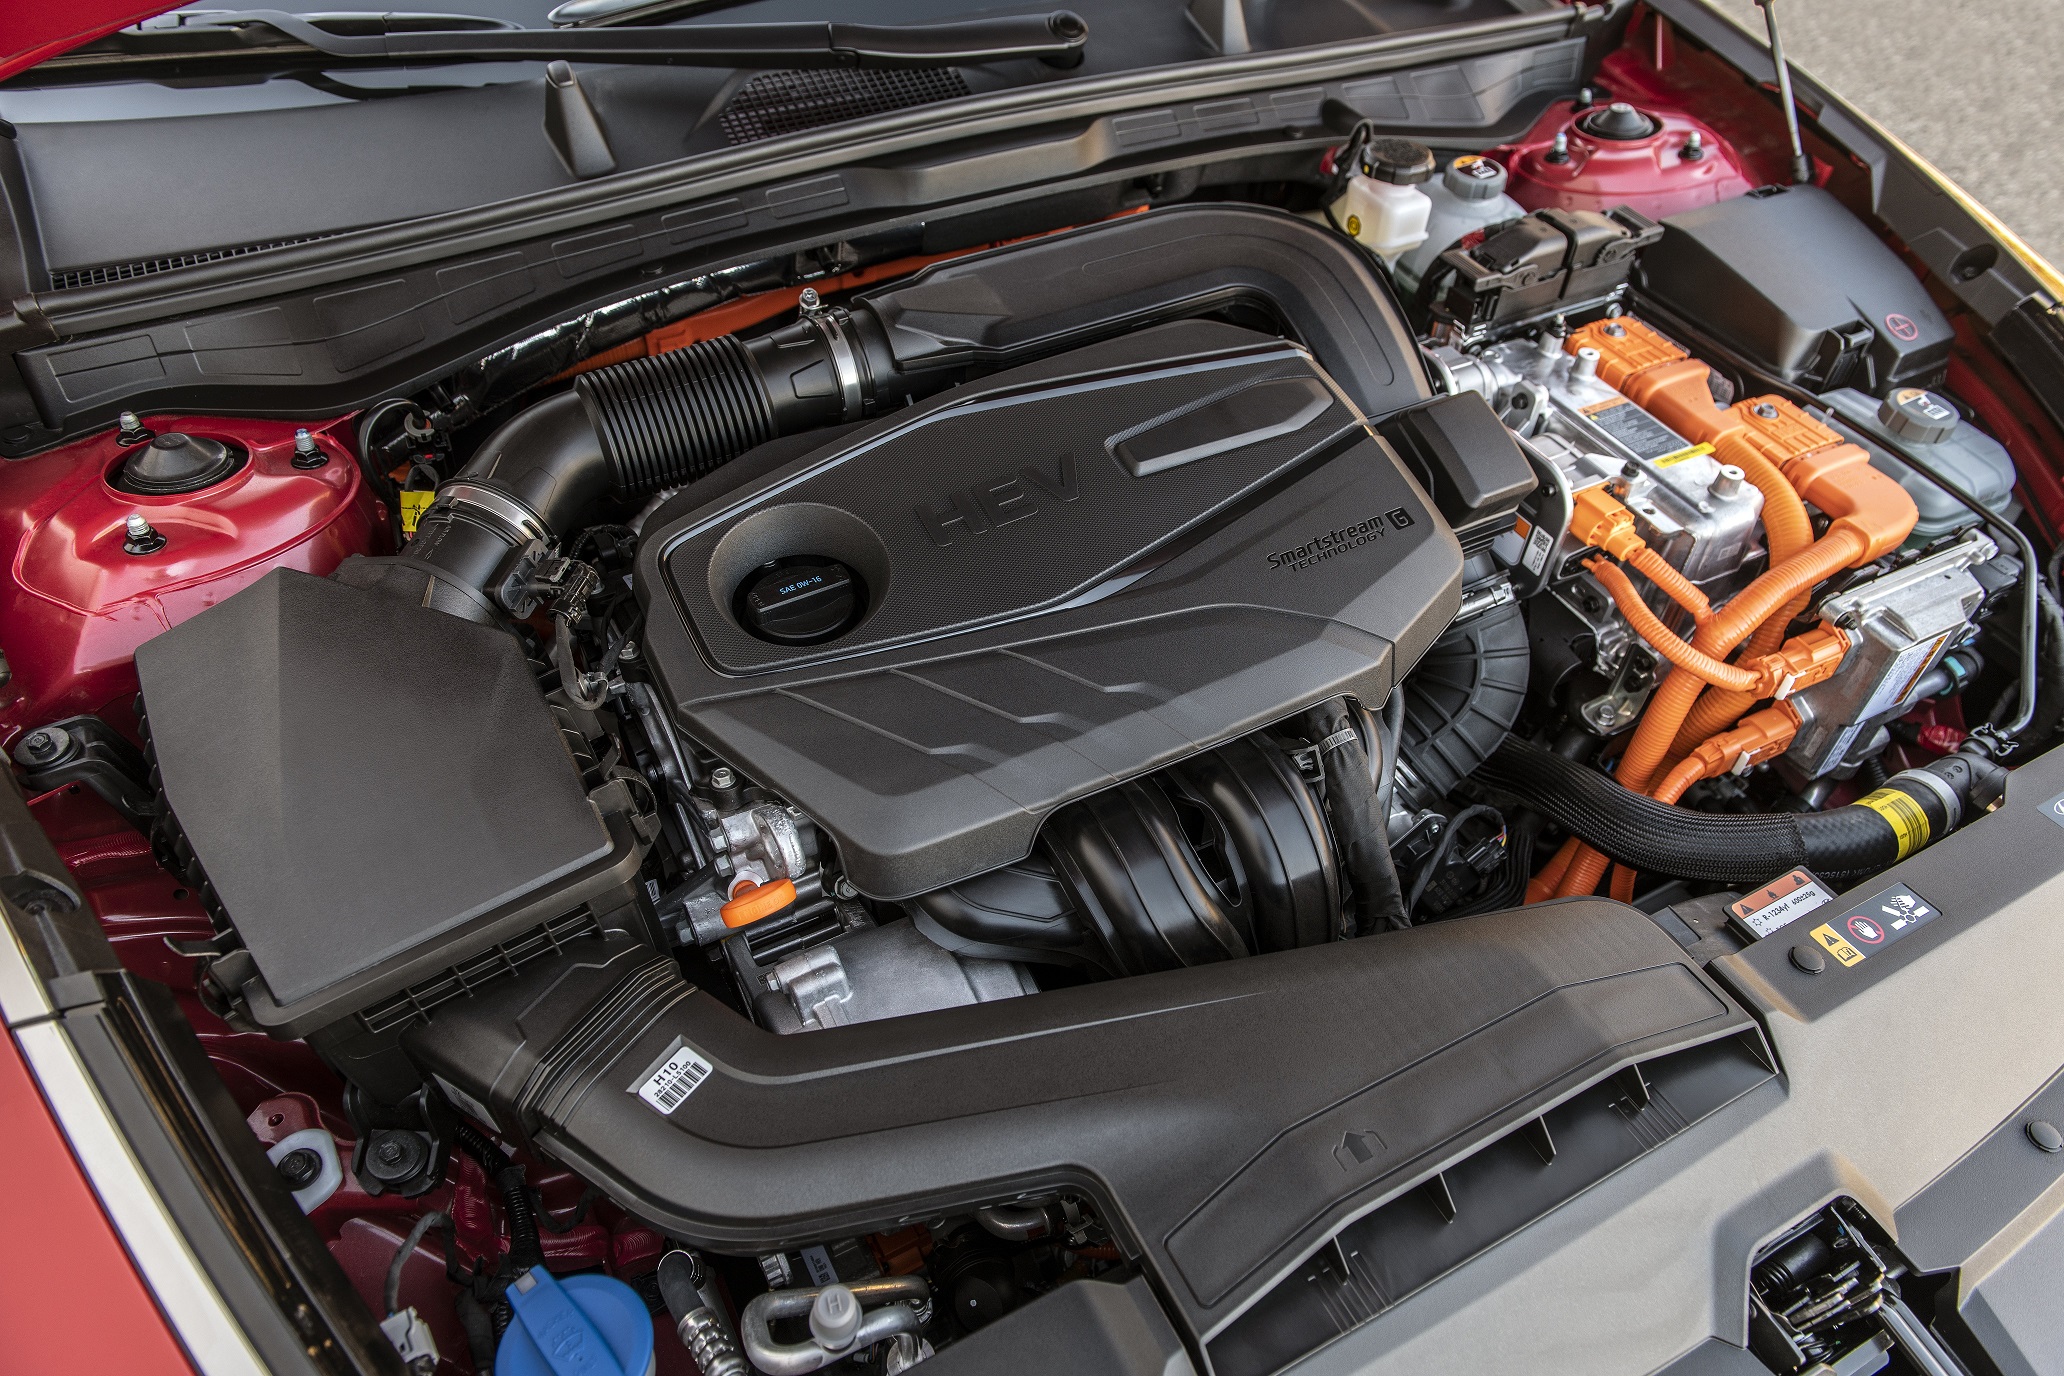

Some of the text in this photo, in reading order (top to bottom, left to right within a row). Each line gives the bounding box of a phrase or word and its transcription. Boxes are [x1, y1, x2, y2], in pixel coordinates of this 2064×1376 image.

[914, 452, 1079, 547] HEV
[1267, 515, 1384, 570] Smartstream
[1288, 527, 1385, 572] TECHNOLOGY
[779, 575, 822, 595] SAE 0W-16
[1762, 902, 1790, 921] R-1234yf
[653, 1062, 679, 1086] H10
[653, 1061, 692, 1098] 28210-L5100
